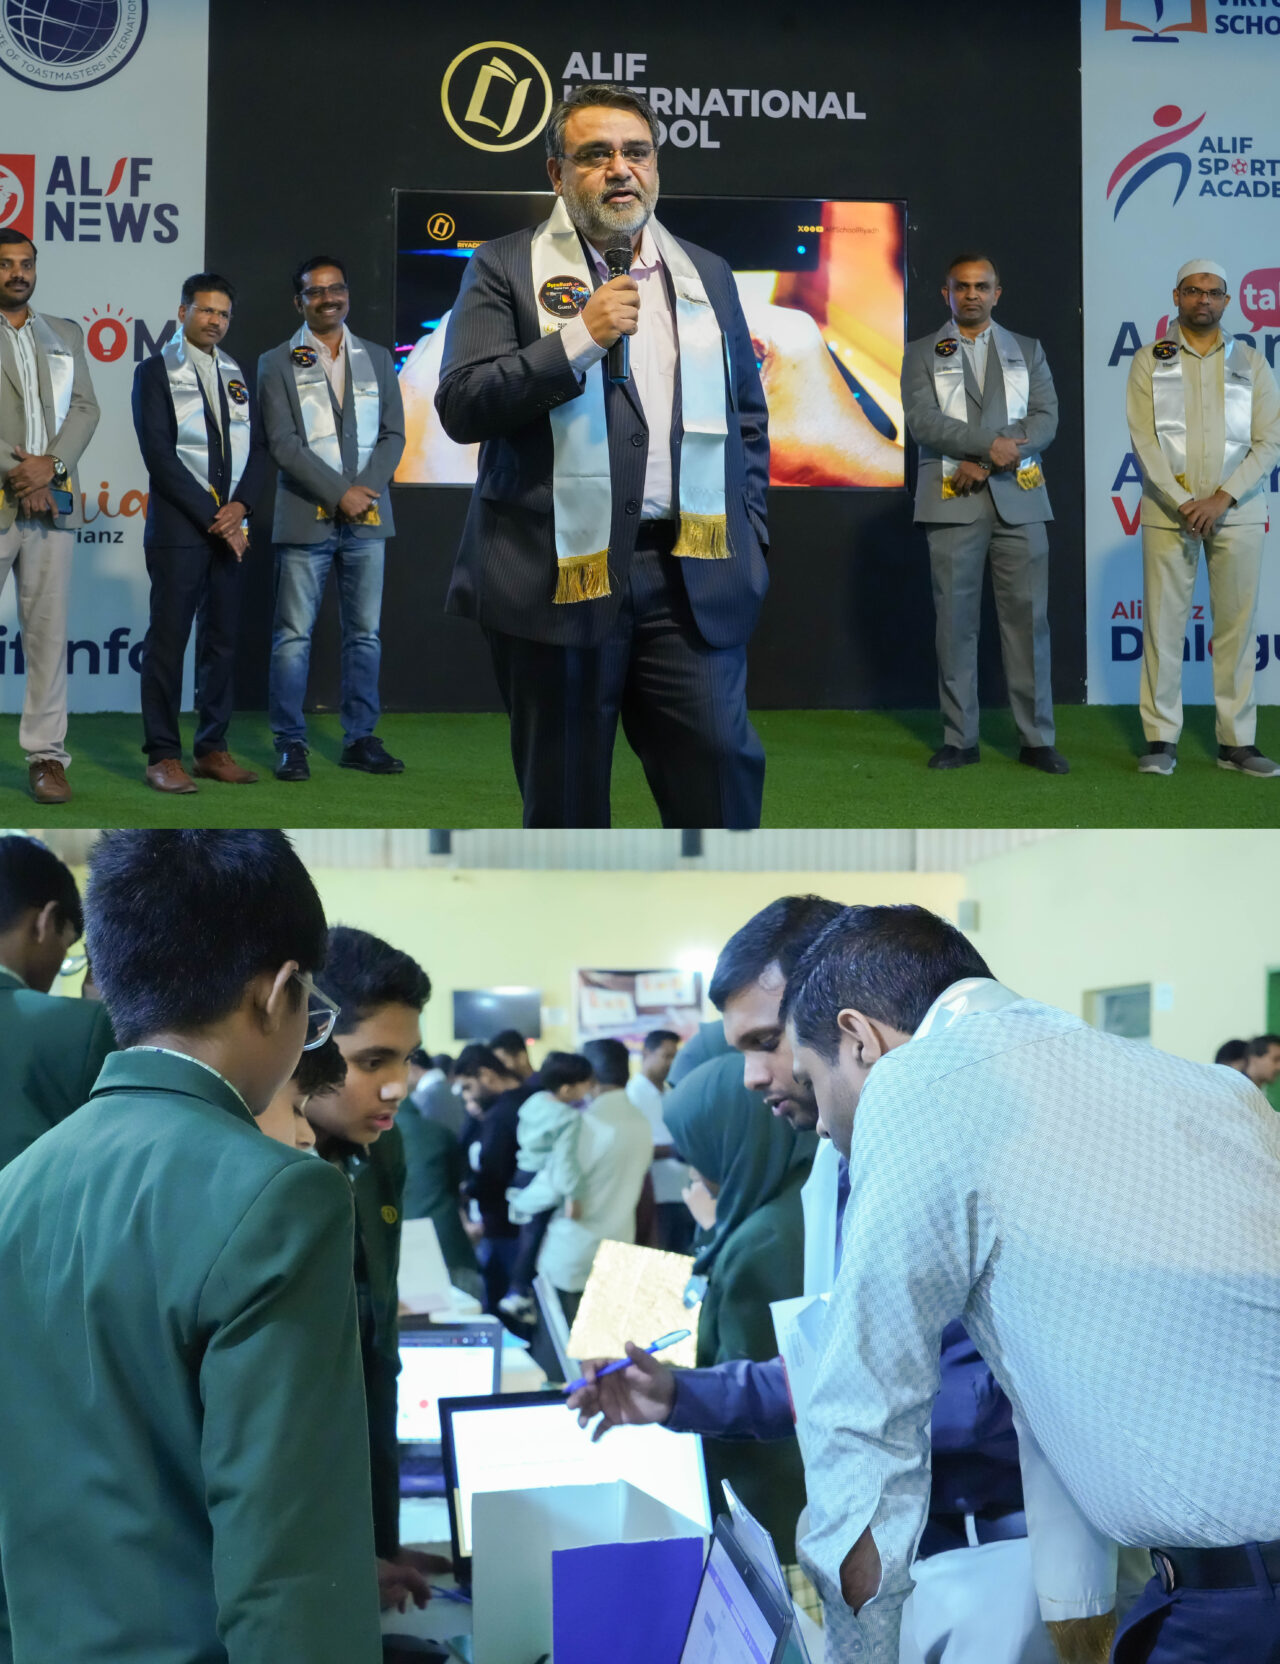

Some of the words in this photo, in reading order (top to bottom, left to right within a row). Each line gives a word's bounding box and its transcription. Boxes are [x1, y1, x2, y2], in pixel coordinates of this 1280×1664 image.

[5, 48, 19, 62] OF
[20, 60, 107, 81] TOASTMASTERS
[561, 51, 648, 81] ALIF
[1198, 136, 1253, 154] ALIF
[45, 155, 153, 198] ALIF
[45, 201, 179, 244] NEWS
